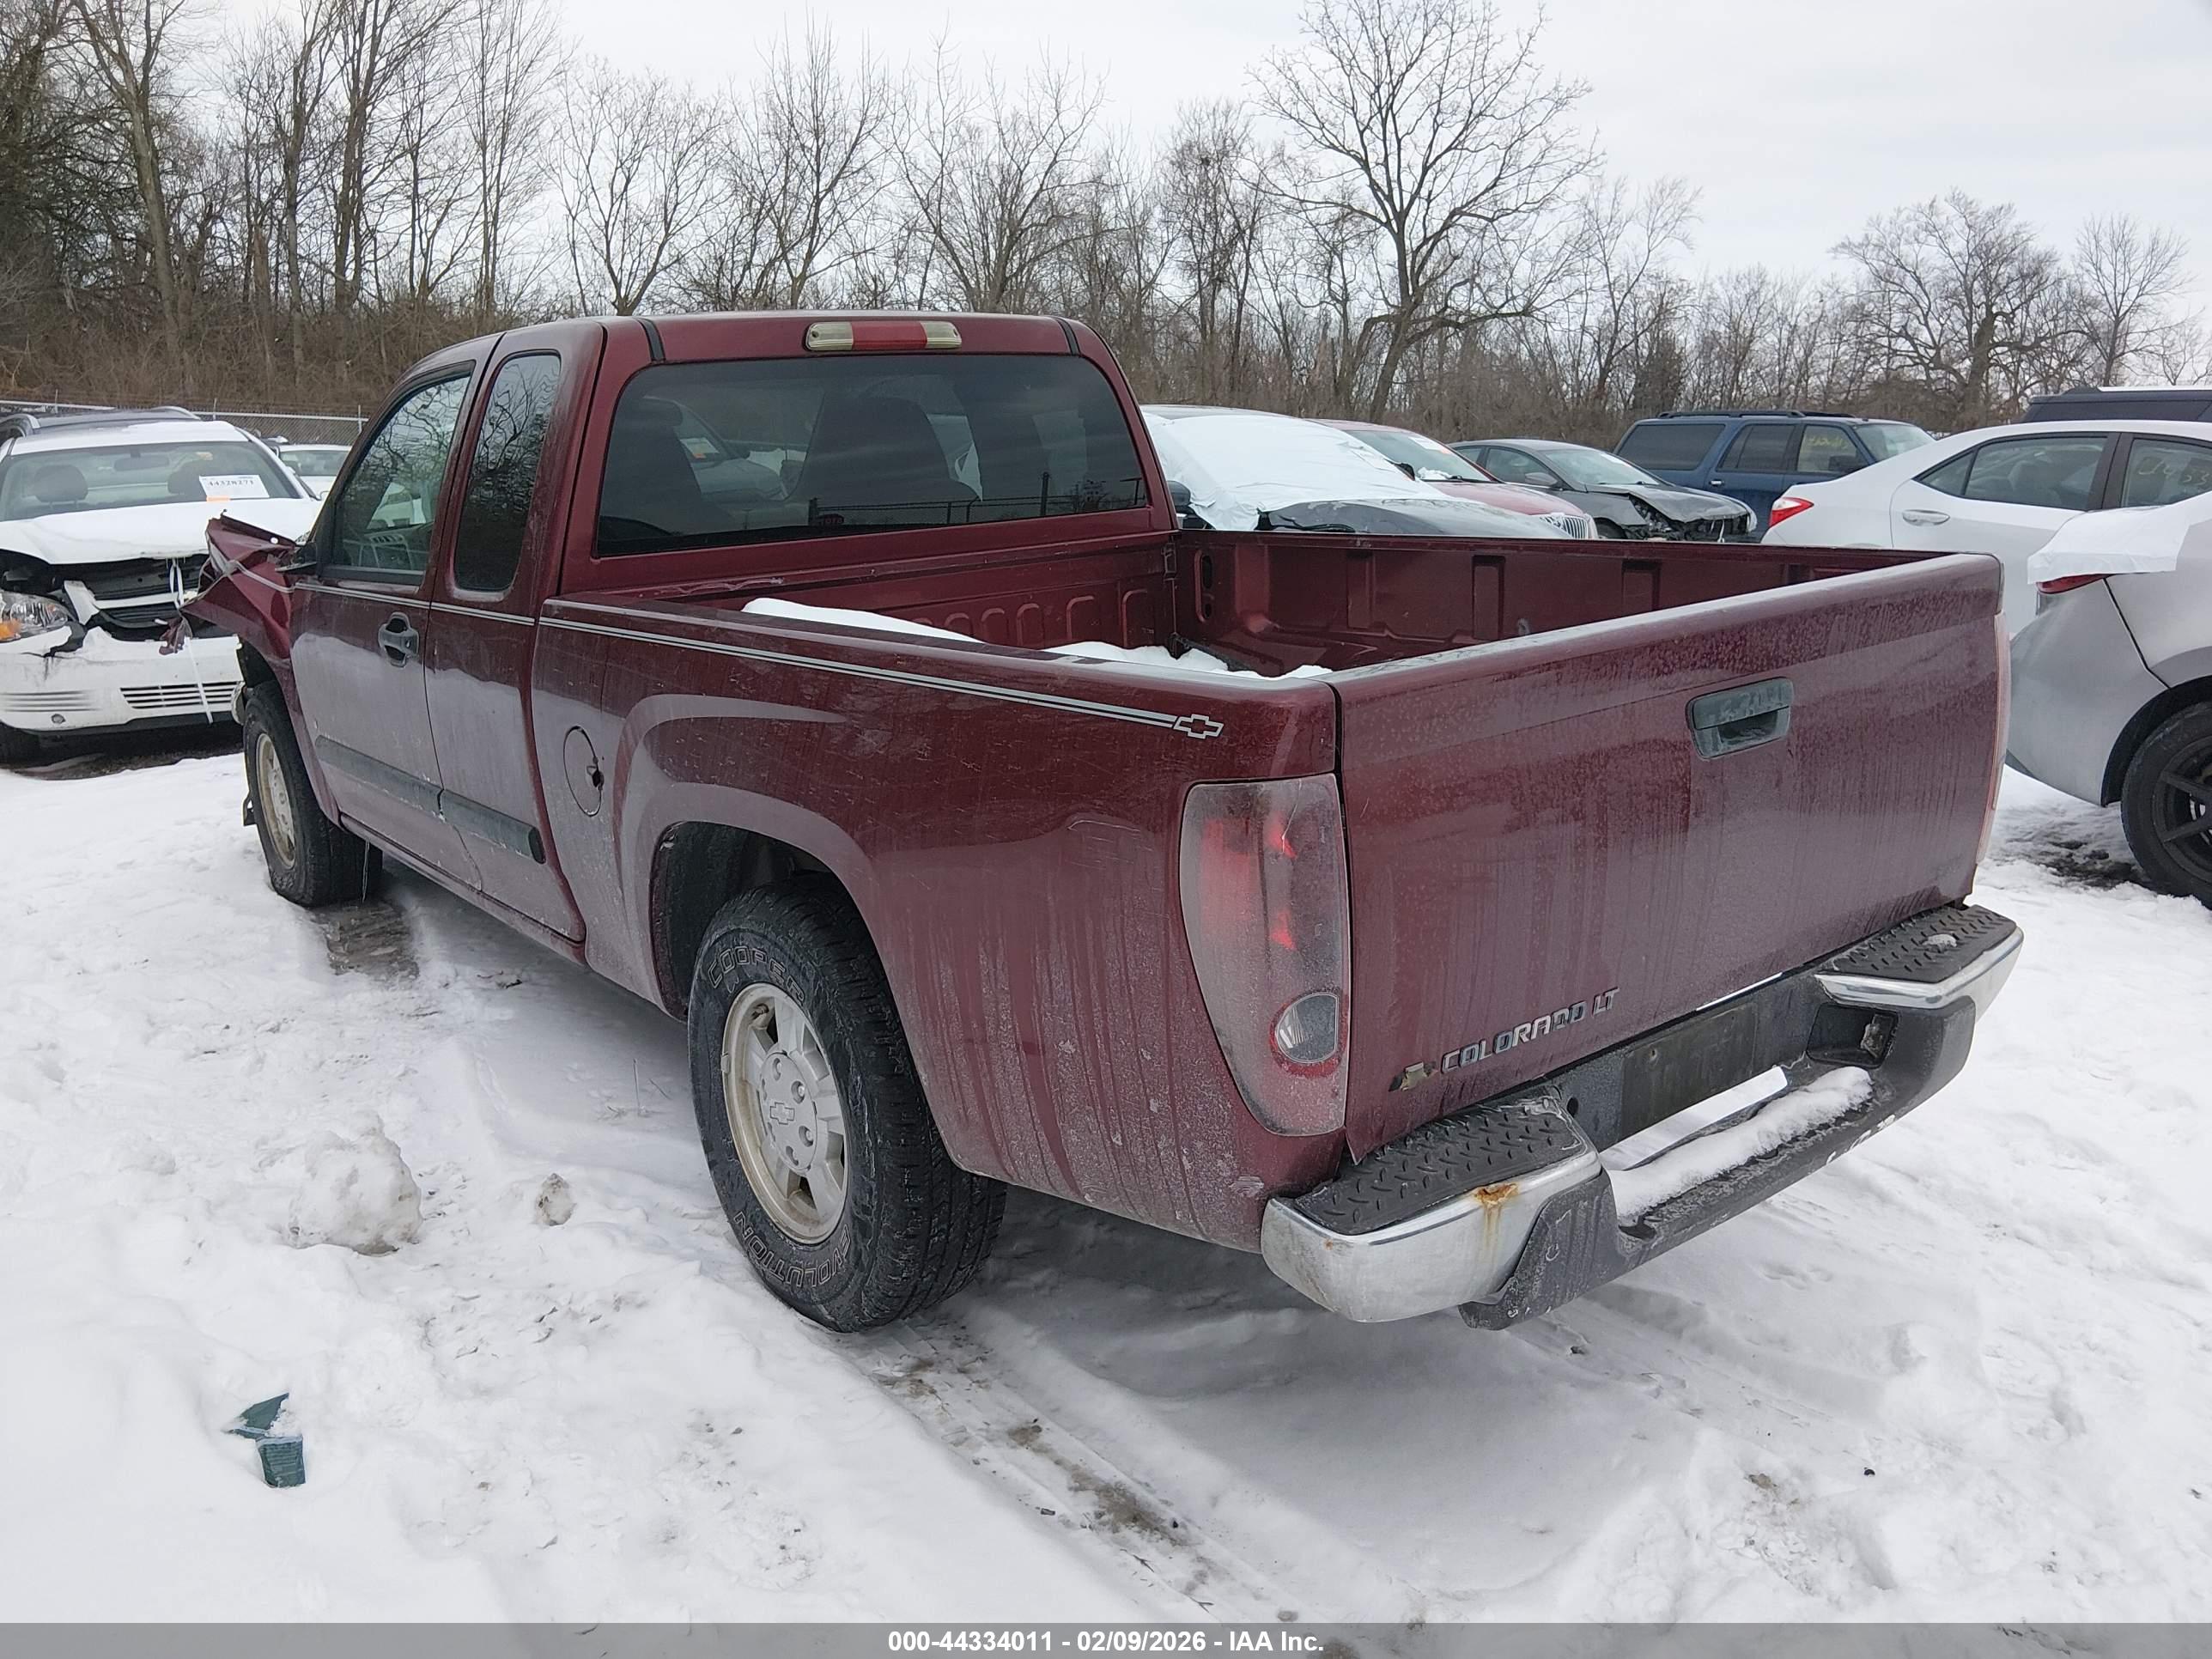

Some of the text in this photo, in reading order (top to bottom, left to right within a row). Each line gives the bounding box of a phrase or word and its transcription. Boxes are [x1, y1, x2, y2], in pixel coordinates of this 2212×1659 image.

[708, 945, 805, 1006] COOPER
[1440, 987, 1620, 1074] COLORADO LT
[733, 1211, 852, 1287] EVOLUTION
